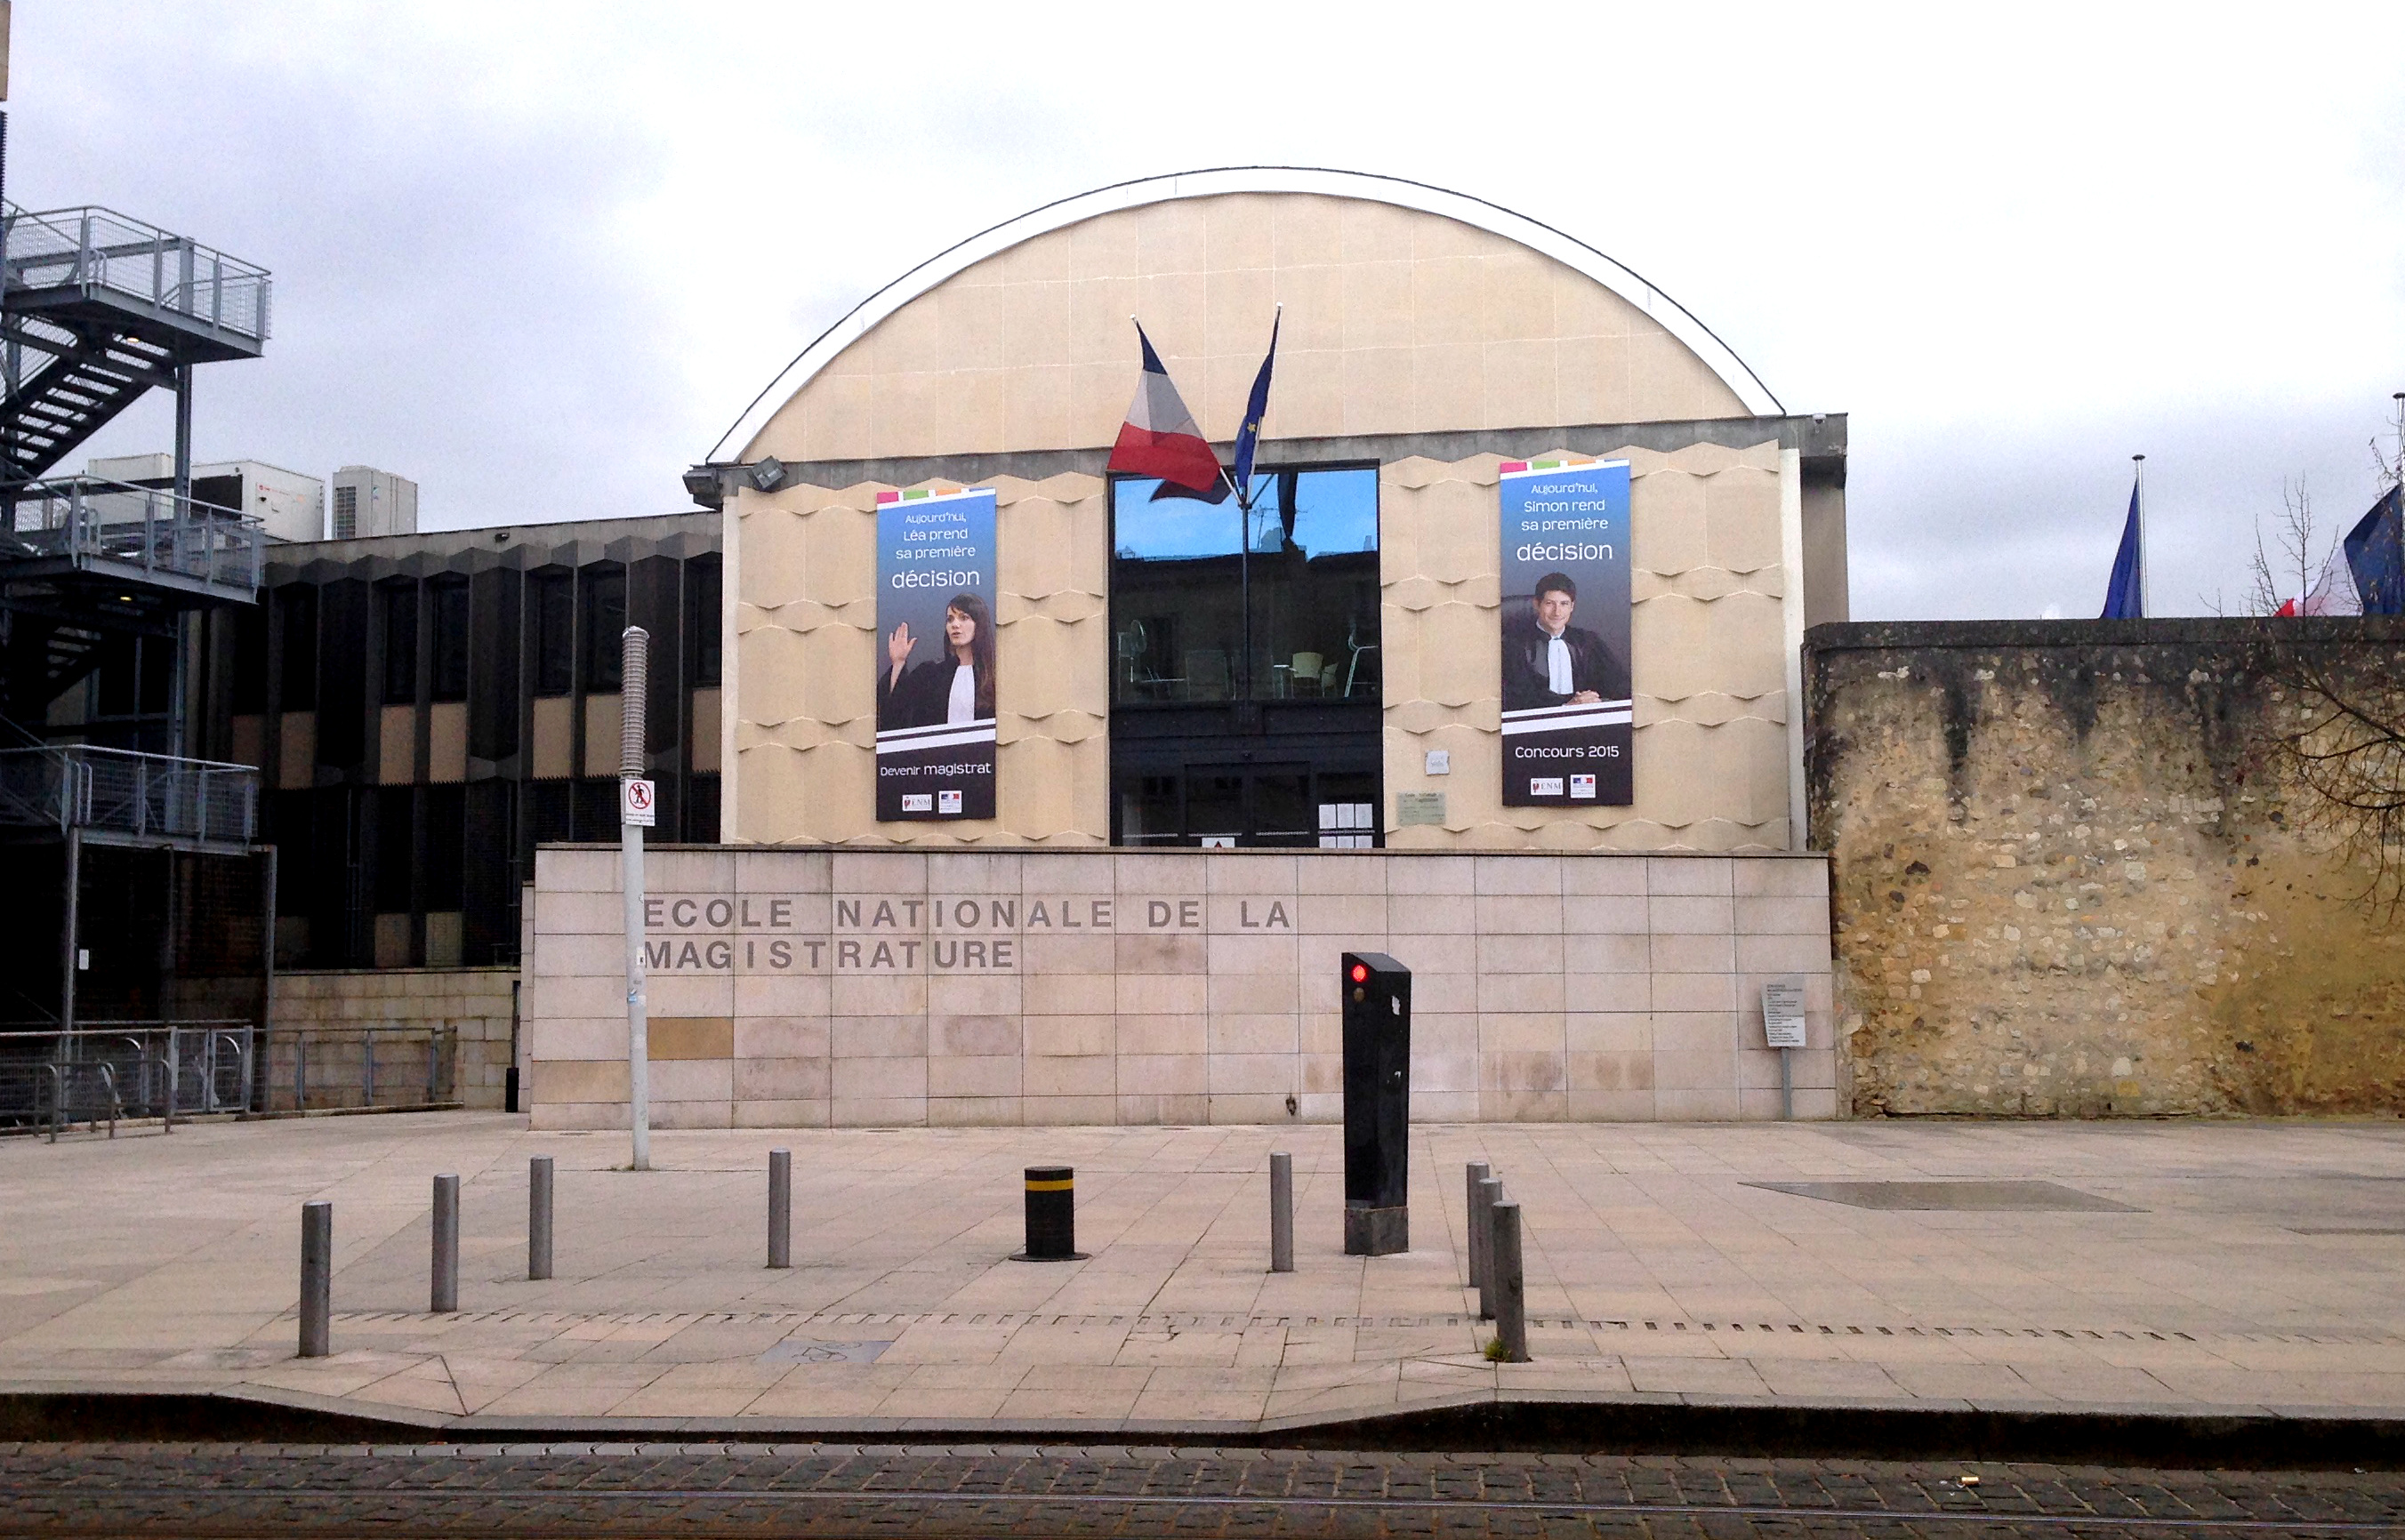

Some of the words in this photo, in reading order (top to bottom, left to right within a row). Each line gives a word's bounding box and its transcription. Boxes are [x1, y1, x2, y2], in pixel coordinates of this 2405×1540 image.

[1524, 500, 1569, 512] Simon
[1572, 499, 1605, 511] rend
[1521, 520, 1539, 531] sa
[1542, 517, 1608, 532] première
[904, 529, 926, 541] Léa
[929, 528, 969, 541] prend
[896, 549, 912, 559] sa
[915, 545, 976, 560] première
[1516, 542, 1613, 561] décision
[891, 569, 980, 589] décision
[1515, 746, 1584, 758] Concours
[1588, 745, 1620, 758] 2015
[880, 766, 921, 776] Devenir
[923, 762, 992, 776] magistrat
[1540, 782, 1561, 790] ENM
[644, 899, 792, 927] ECOLE
[837, 900, 1112, 927] NATIONALE
[1147, 900, 1200, 928] DE
[1240, 901, 1291, 928] LA
[645, 940, 1013, 969] MAGISTRATURE
